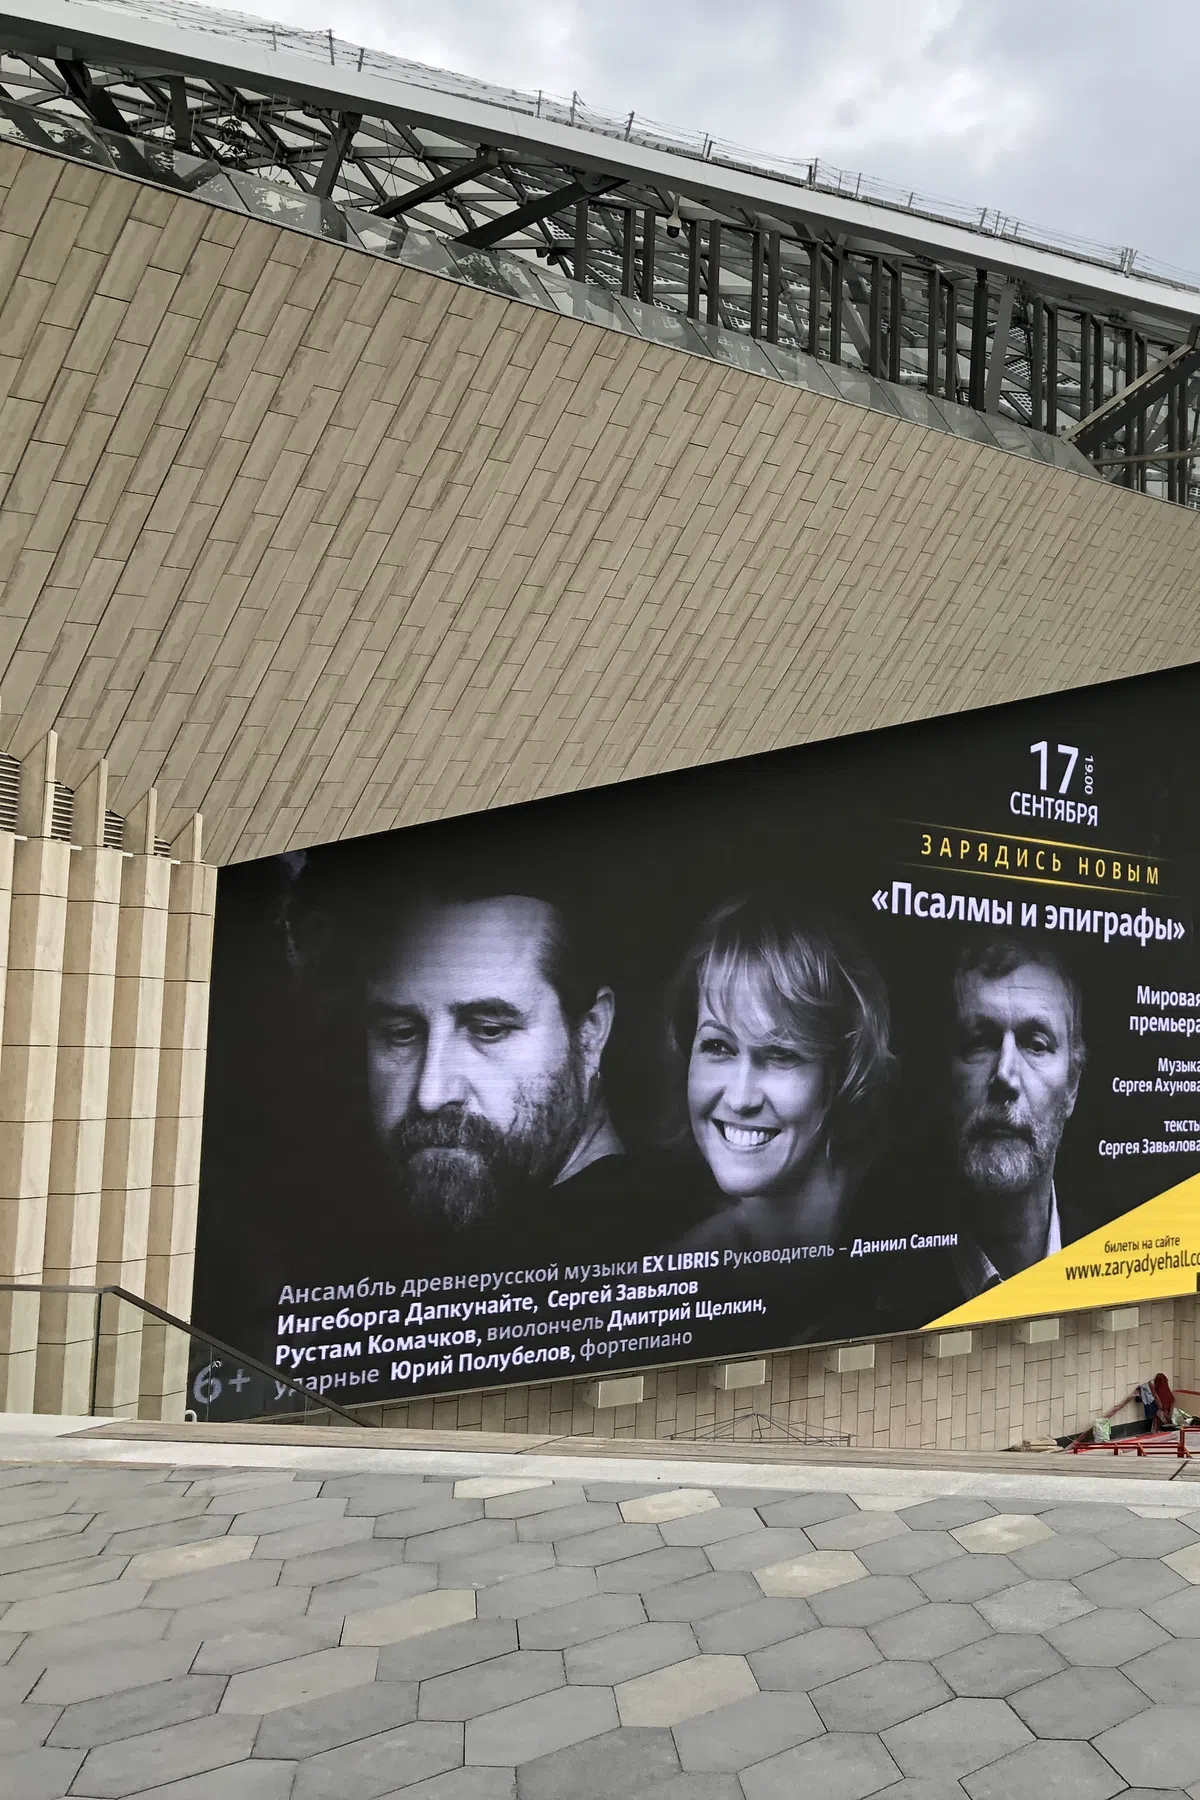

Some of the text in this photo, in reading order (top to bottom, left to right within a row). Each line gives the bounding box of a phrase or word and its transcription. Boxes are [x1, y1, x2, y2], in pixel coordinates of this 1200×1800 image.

[1030, 740, 1079, 793] 17
[1084, 755, 1094, 795] 19.00
[1010, 791, 1099, 827] СЕНТЯБРЯ
[920, 834, 1160, 885] ЗАРЯДИСЬ НОВЫМ
[872, 881, 1186, 947] «Псалмы и эпиграфы»
[1112, 1077, 1152, 1097] Сергея
[1098, 1139, 1140, 1159] Сергея
[278, 1277, 396, 1305] Ансамбль
[401, 1262, 559, 1299] древнерусской
[564, 1257, 638, 1283] музыки
[642, 1255, 664, 1274] EX
[667, 1250, 720, 1272] LIBRIS
[723, 1243, 835, 1269] Руководитель
[850, 1236, 907, 1257] Даниил
[910, 1231, 959, 1250] Саяпин
[1104, 1234, 1181, 1254] билеты на сайте
[277, 1278, 698, 1336] Ингеборга Дапкунайте, Сергей Завьялов
[275, 1297, 767, 1369] Рустам Комачков, виолончель Дмитрий Щелкин,
[193, 1360, 250, 1405] 6+
[274, 1329, 692, 1401] уарные Юрий Полубелов, фортепиано
